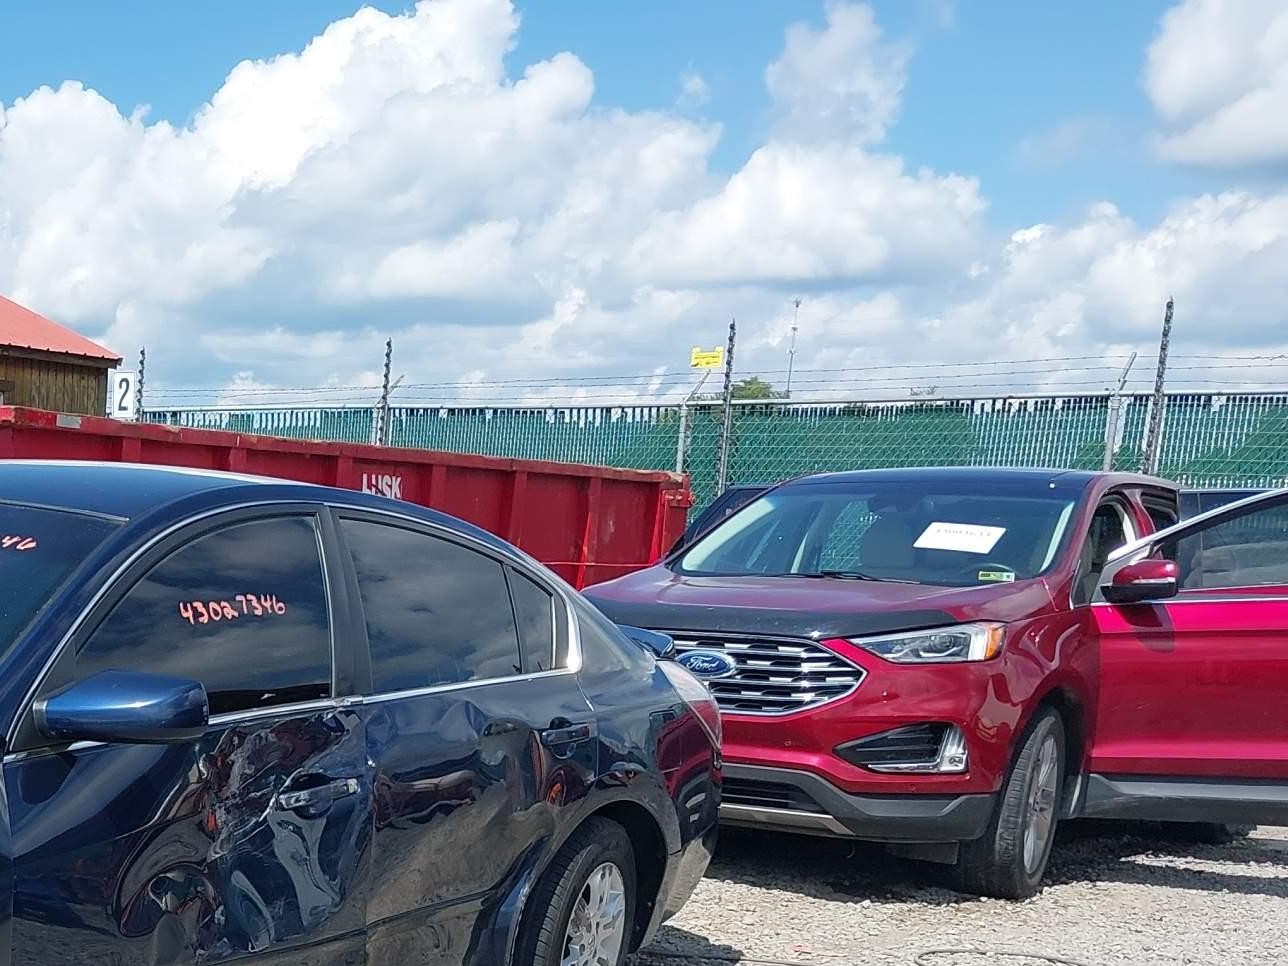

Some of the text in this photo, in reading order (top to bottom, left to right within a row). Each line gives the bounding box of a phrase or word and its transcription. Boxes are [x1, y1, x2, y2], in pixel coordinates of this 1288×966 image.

[118, 377, 130, 411] 2
[362, 473, 402, 499] LUSK
[179, 594, 286, 624] 43027346
[686, 656, 719, 671] Ford
